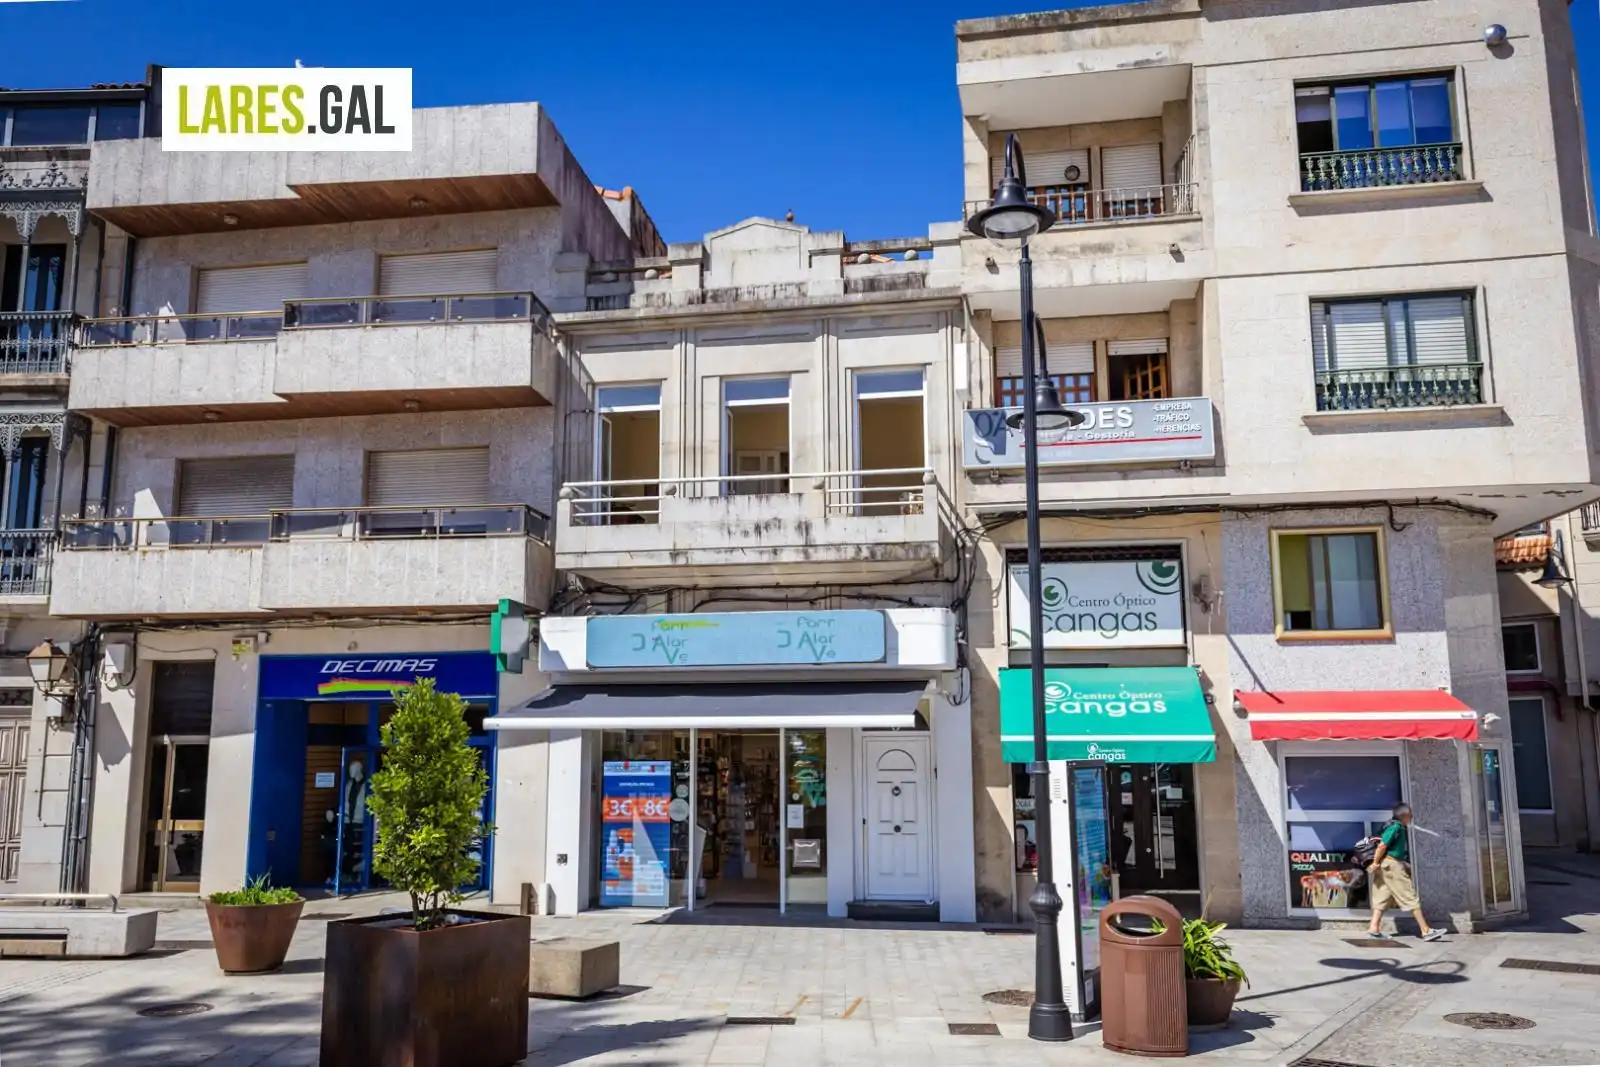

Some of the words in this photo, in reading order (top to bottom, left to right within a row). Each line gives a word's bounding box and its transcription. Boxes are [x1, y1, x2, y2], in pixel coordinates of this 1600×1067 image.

[1068, 595, 1110, 608] Centro
[1113, 592, 1157, 610] Óptico
[320, 658, 438, 674] DECIMAS
[1073, 691, 1116, 700] Centro
[1088, 753, 1126, 762] cangas
[1290, 853, 1346, 863] QUALITY
